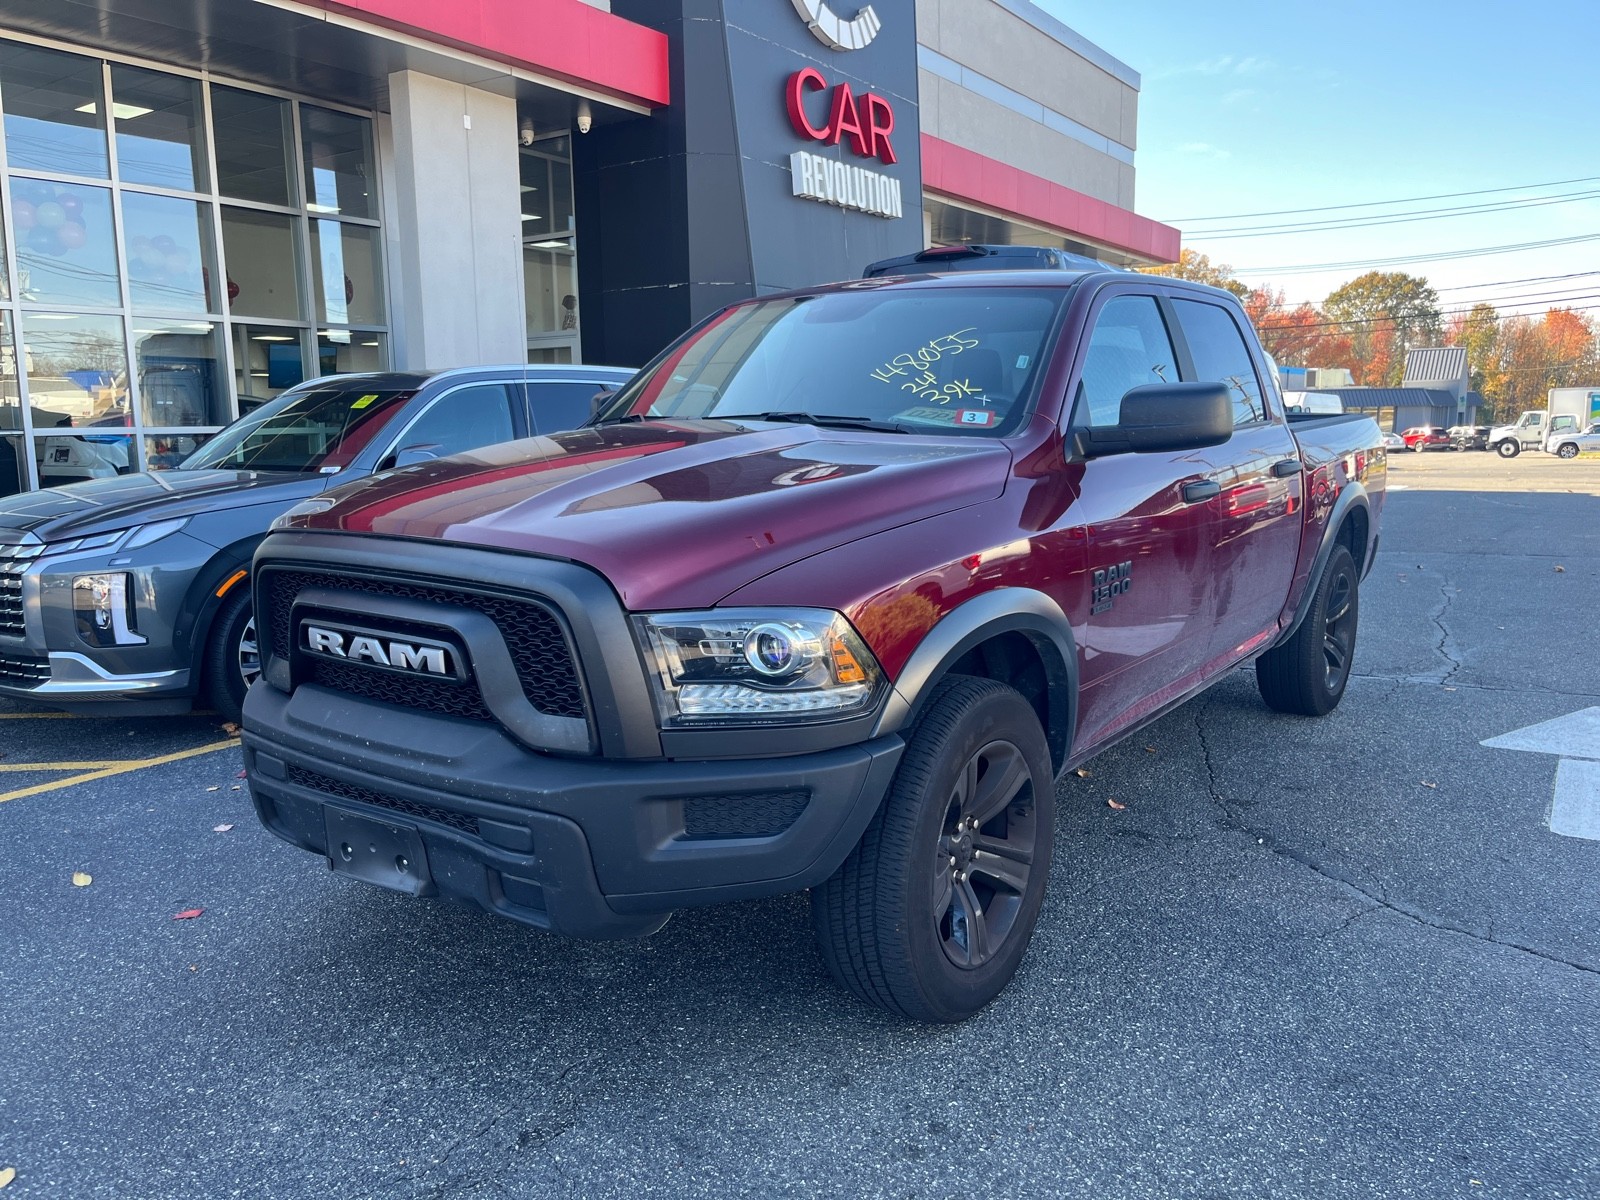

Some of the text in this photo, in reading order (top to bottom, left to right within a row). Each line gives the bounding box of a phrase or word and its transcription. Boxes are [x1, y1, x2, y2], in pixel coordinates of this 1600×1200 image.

[787, 66, 898, 165] CAR
[790, 150, 902, 219] REVOLUTION
[870, 327, 979, 383] 148055
[901, 371, 937, 393] 24
[920, 378, 982, 405] 39K
[967, 412, 977, 422] 3
[1092, 560, 1132, 587] RAM
[1092, 577, 1131, 604] 1500
[308, 626, 446, 674] RAM
